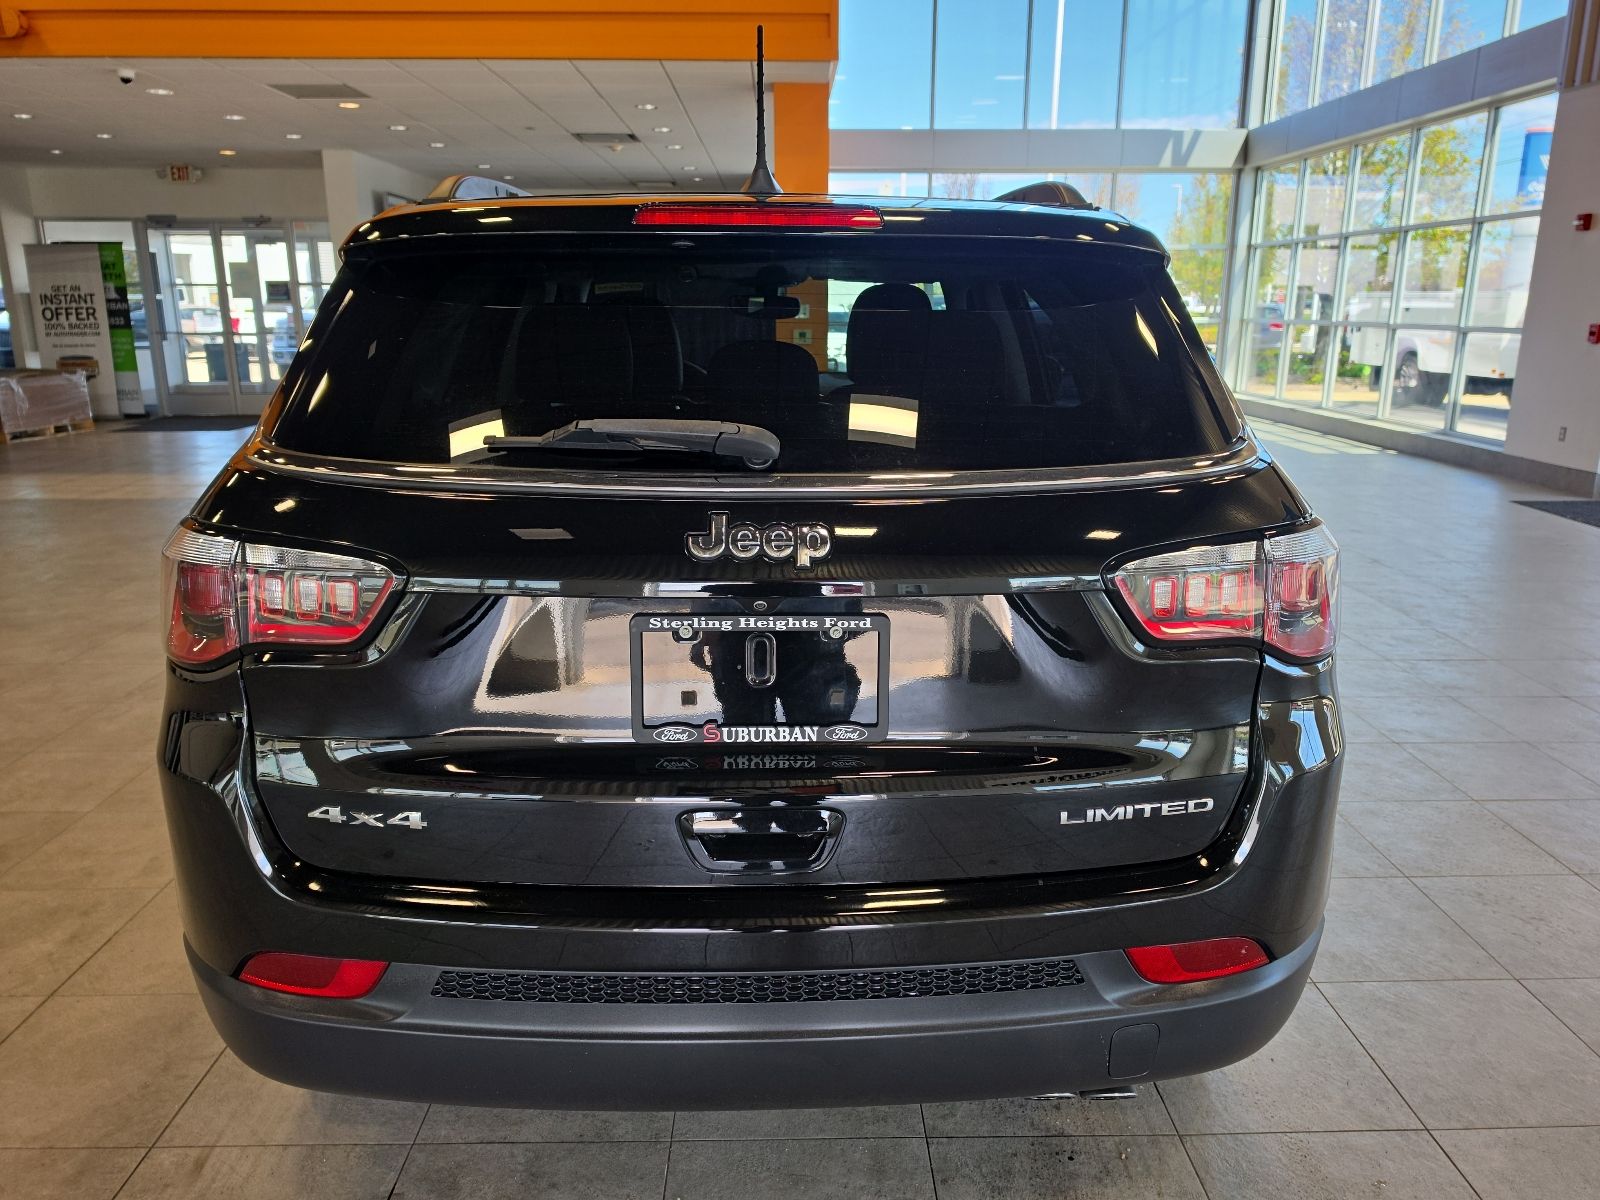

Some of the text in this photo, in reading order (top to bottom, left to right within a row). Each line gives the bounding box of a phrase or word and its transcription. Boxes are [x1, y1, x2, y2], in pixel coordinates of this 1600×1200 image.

[170, 165, 189, 182] EXIT
[50, 283, 81, 293] GET AN
[39, 292, 96, 305] INSTANT
[41, 306, 98, 322] OFFER
[44, 322, 100, 332] 100% BACKED
[686, 511, 831, 569] Jeep
[649, 617, 872, 630] Sterling Heights Ford
[658, 722, 863, 743] Ford SUBURBAN Ford
[307, 805, 428, 830] 4x4
[1059, 797, 1214, 825] LIMITED
